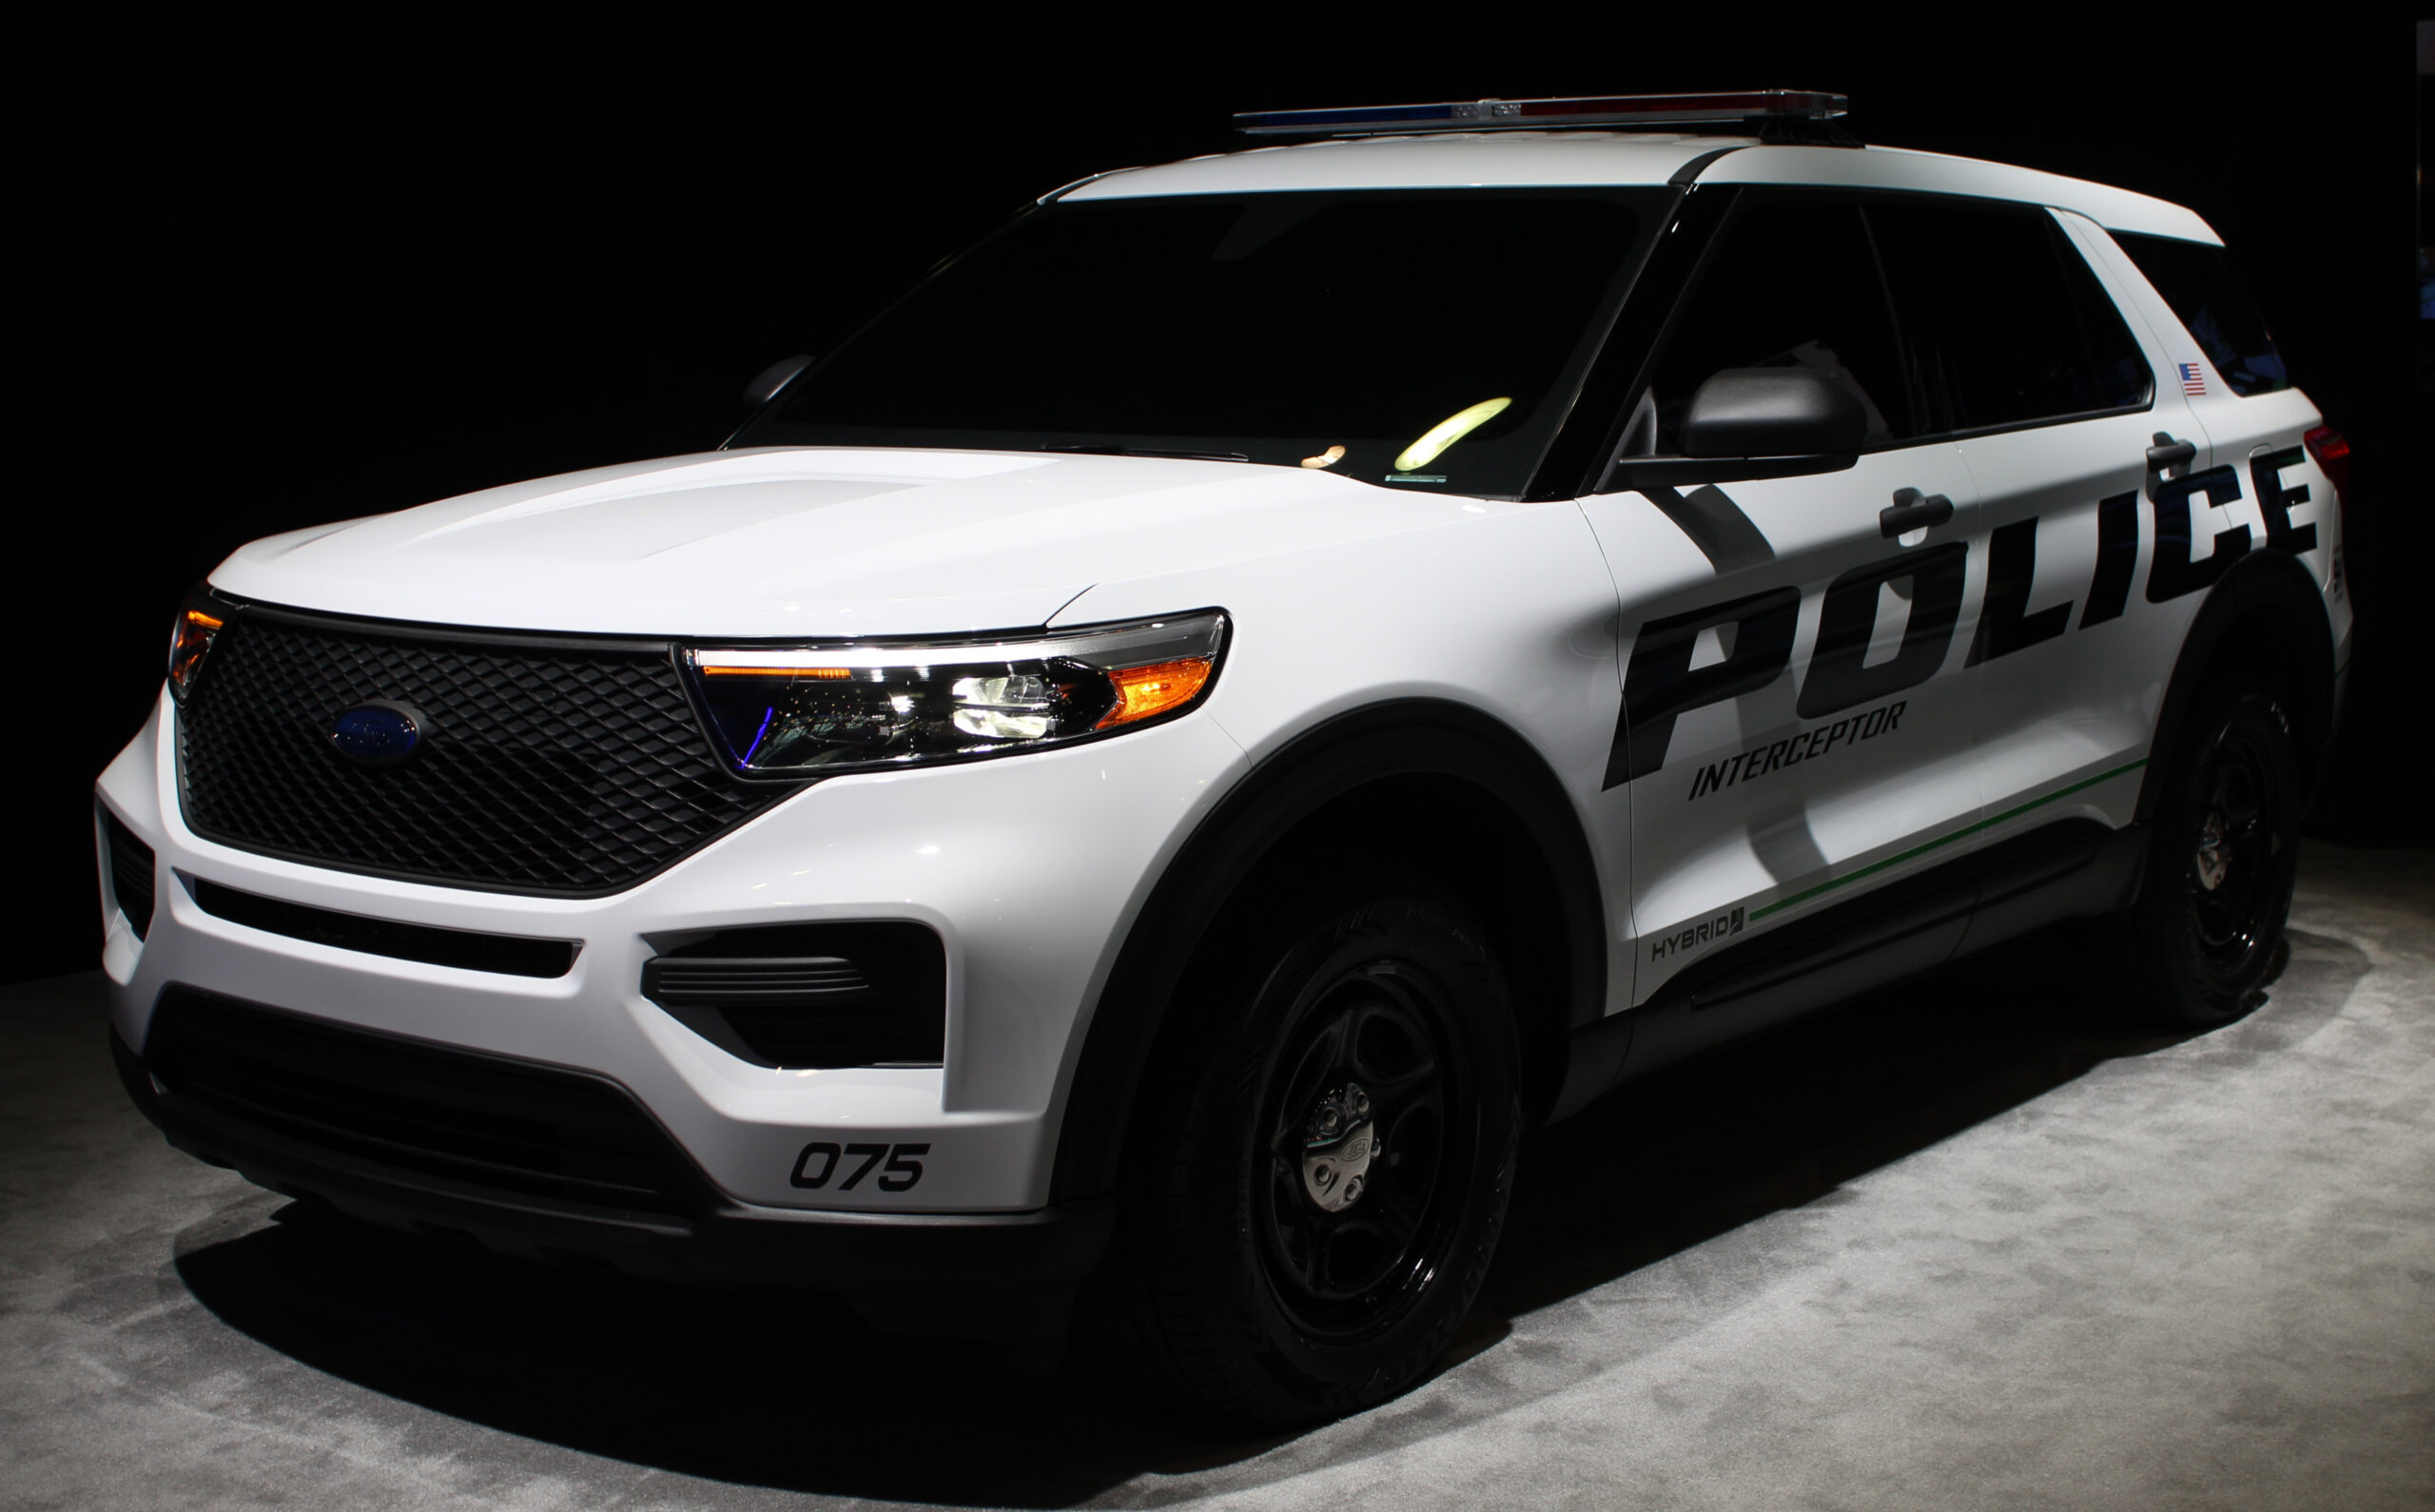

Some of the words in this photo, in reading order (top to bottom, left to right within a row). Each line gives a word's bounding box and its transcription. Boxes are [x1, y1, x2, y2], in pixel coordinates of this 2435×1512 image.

[1602, 445, 2318, 792] POLICE
[1687, 700, 1908, 802] INTERCEPTOR
[1651, 916, 1729, 962] HYBRID
[789, 1141, 931, 1192] 075
